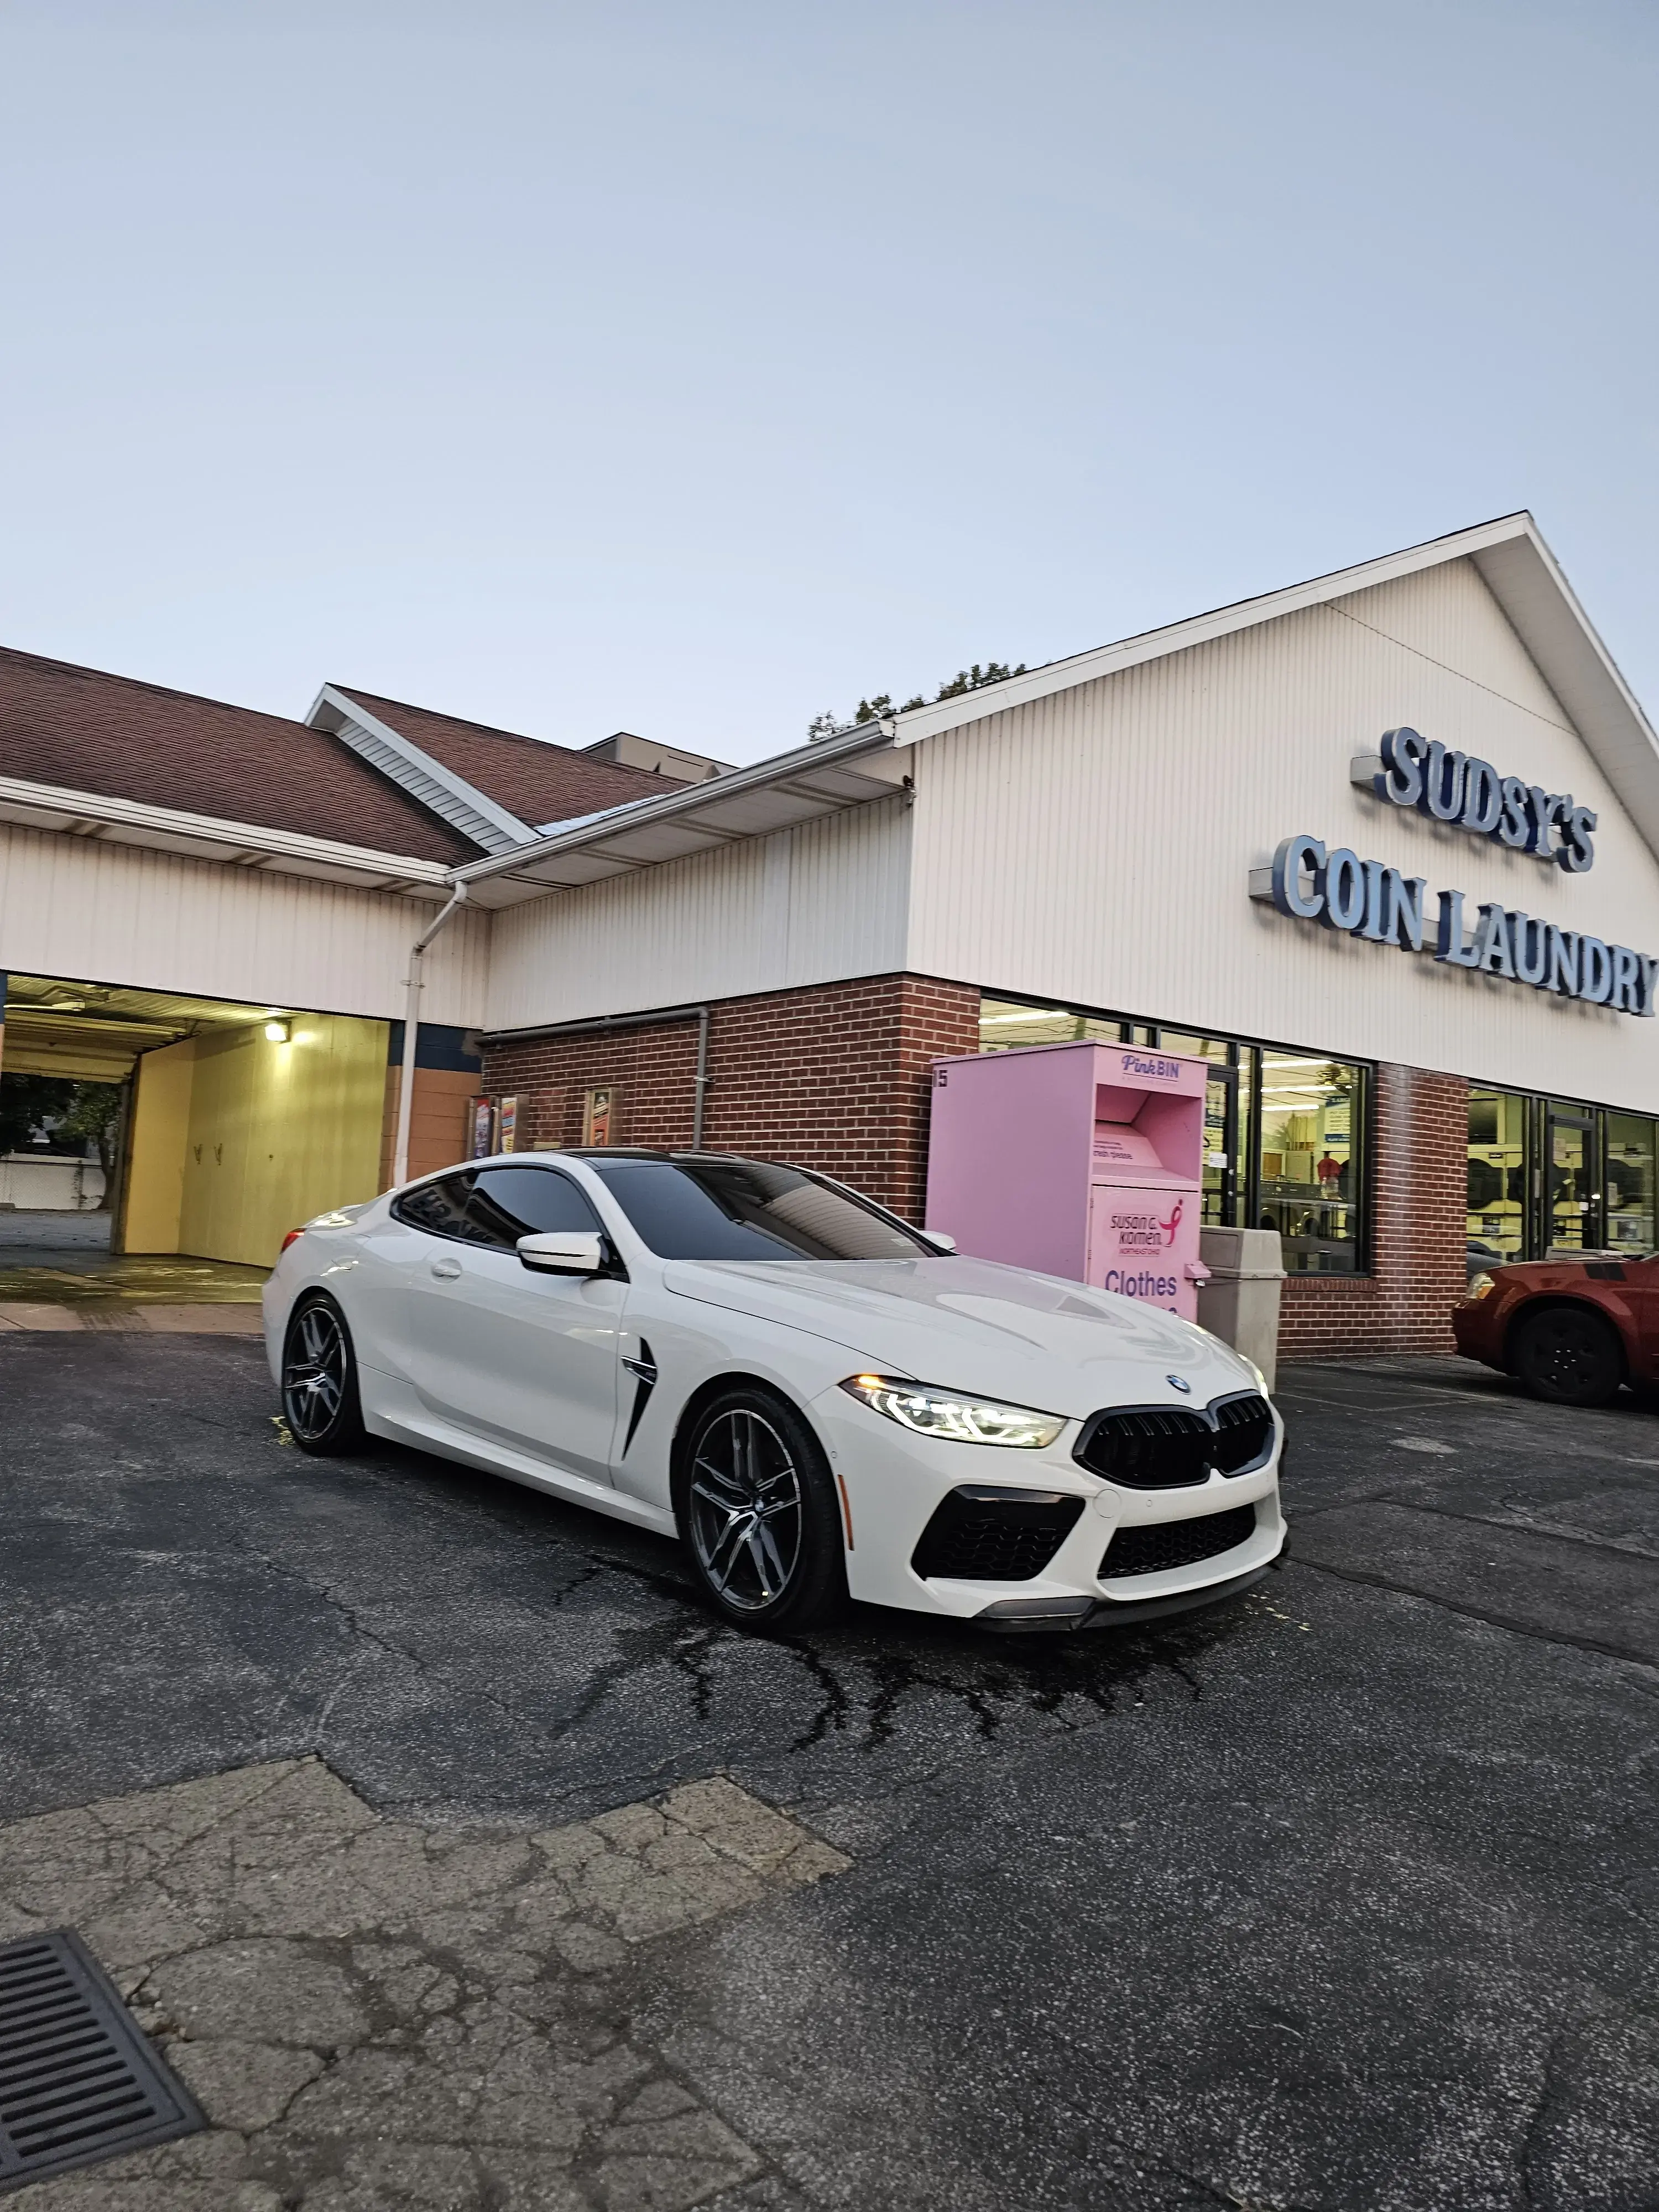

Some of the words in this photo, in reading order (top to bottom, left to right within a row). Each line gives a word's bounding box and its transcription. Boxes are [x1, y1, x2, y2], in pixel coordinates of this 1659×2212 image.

[1374, 727, 1598, 873] SUDSY'S
[1272, 835, 1427, 952] COIN
[1434, 889, 1658, 1018] LAUNDRY
[1105, 1270, 1177, 1297] Clothes
